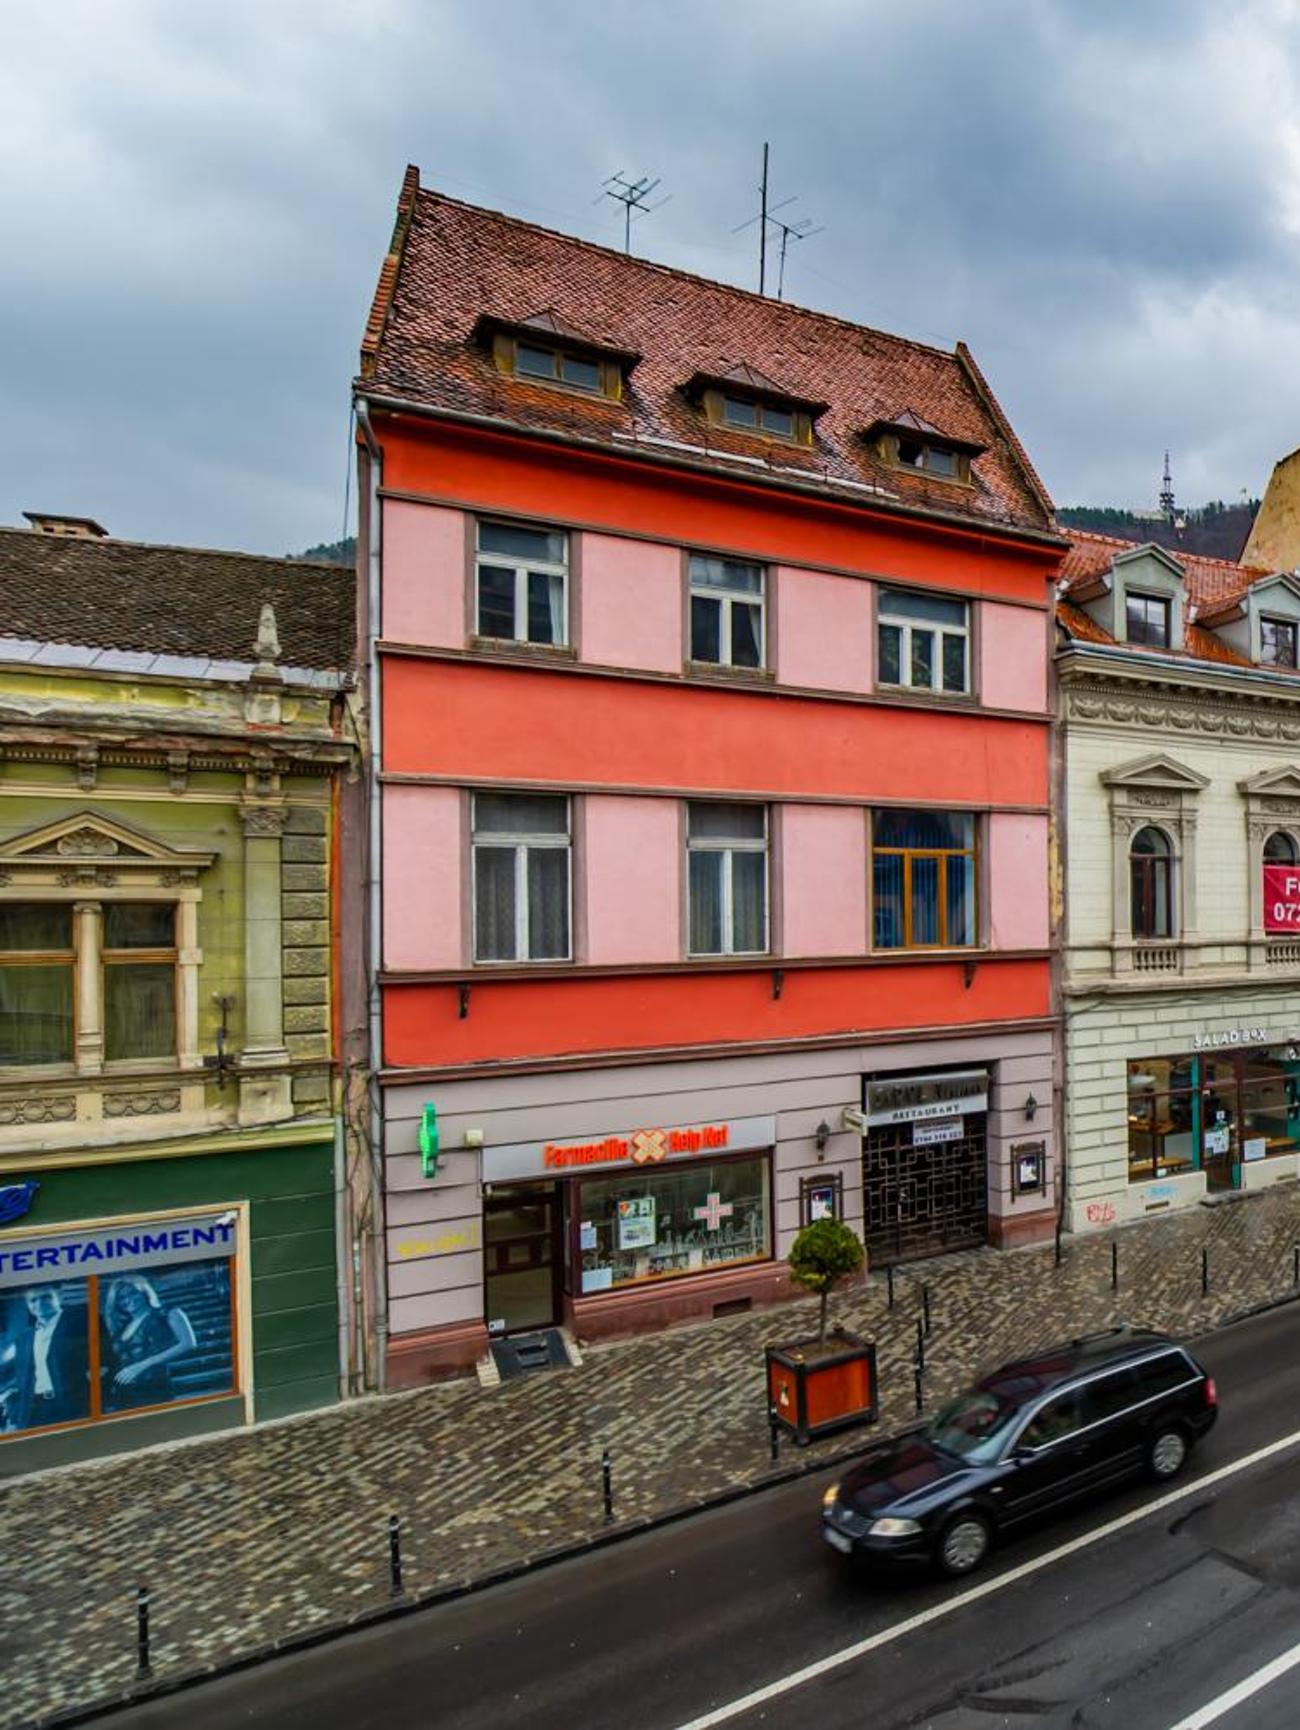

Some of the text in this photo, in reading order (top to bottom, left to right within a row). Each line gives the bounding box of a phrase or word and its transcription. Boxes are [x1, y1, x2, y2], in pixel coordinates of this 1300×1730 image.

[1194, 1030, 1239, 1048] SALAD
[669, 1130, 700, 1153] Help
[703, 1123, 728, 1148] Net
